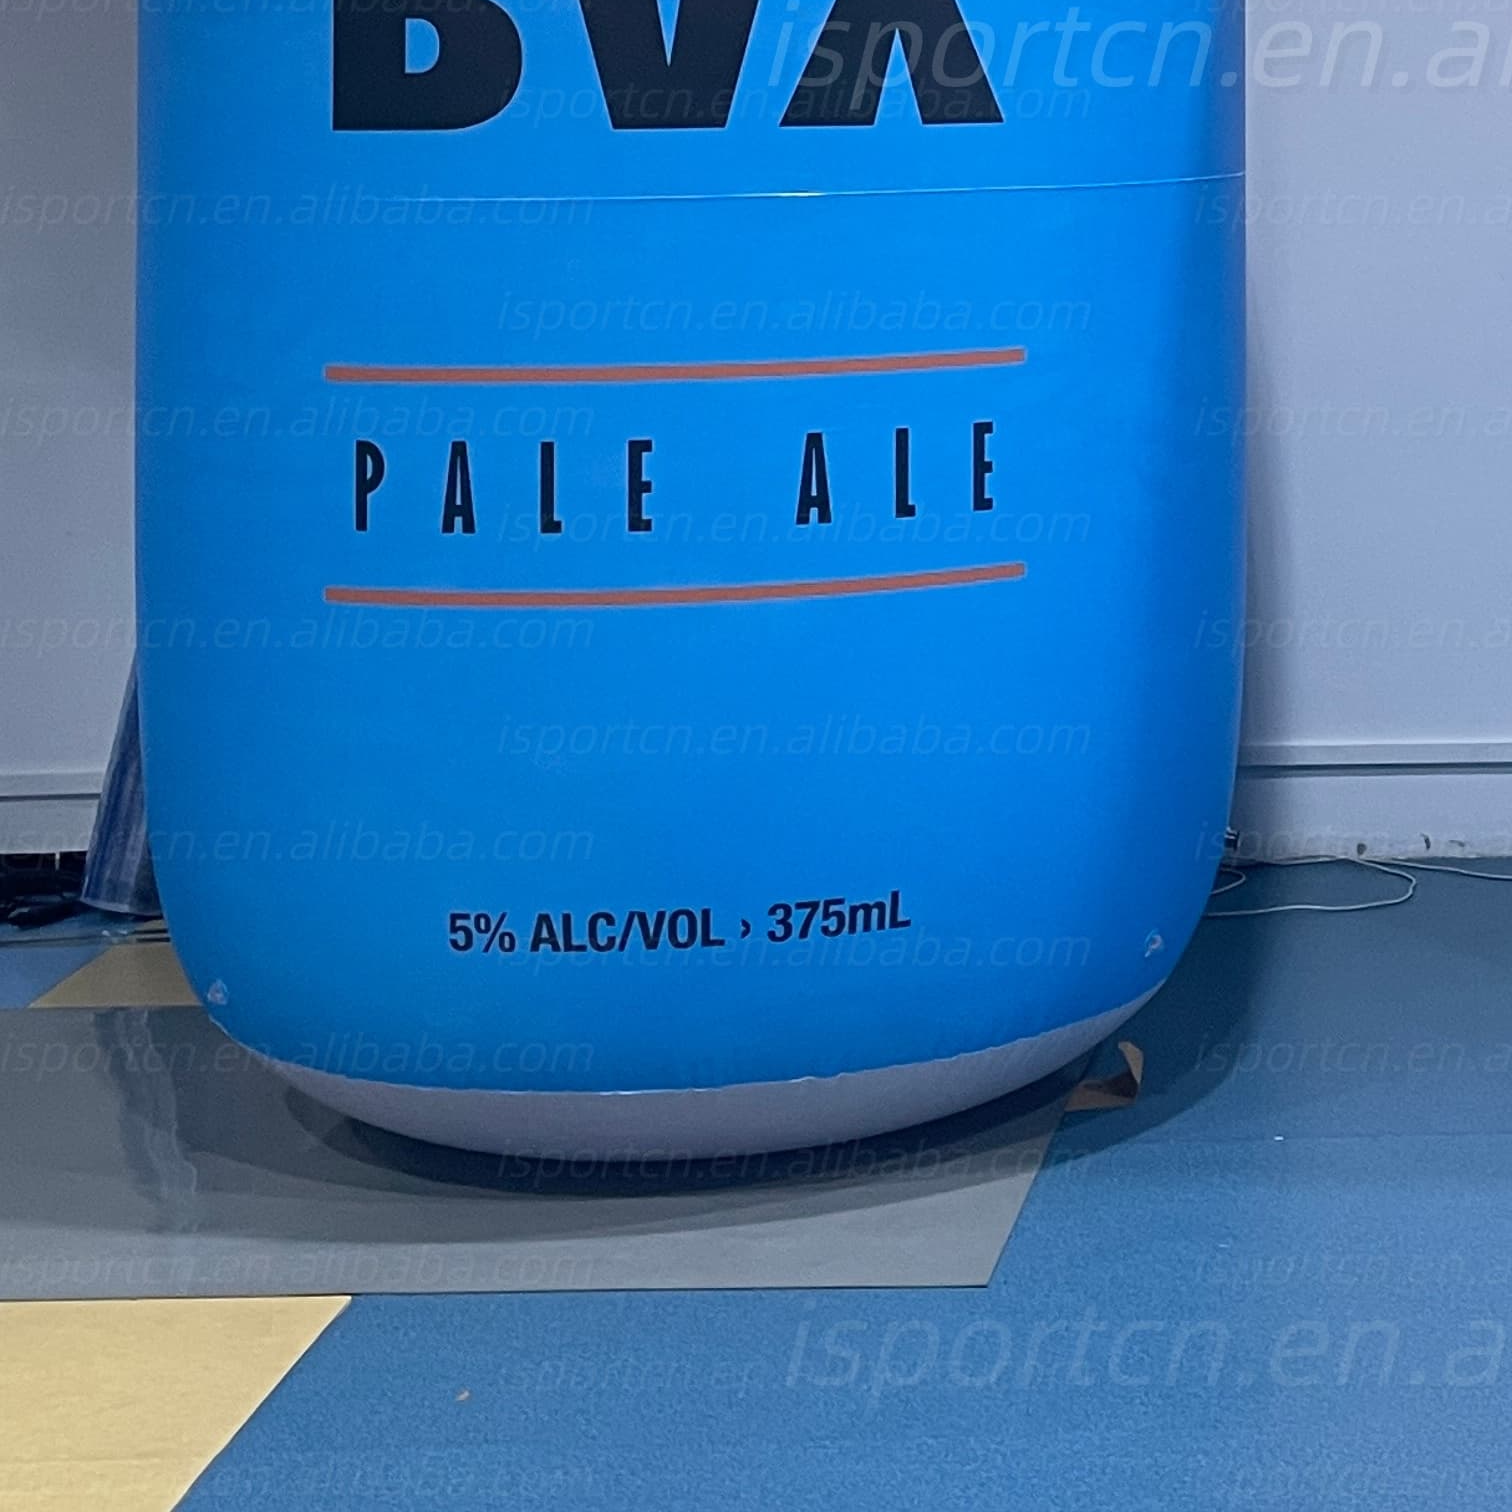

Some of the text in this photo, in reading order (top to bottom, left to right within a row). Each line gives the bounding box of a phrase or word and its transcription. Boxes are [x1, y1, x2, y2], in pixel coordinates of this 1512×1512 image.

[354, 421, 994, 535] PALE ALE
[447, 911, 517, 954] 5%
[529, 907, 727, 954] ALC/VOL
[766, 890, 912, 943] 375mL
